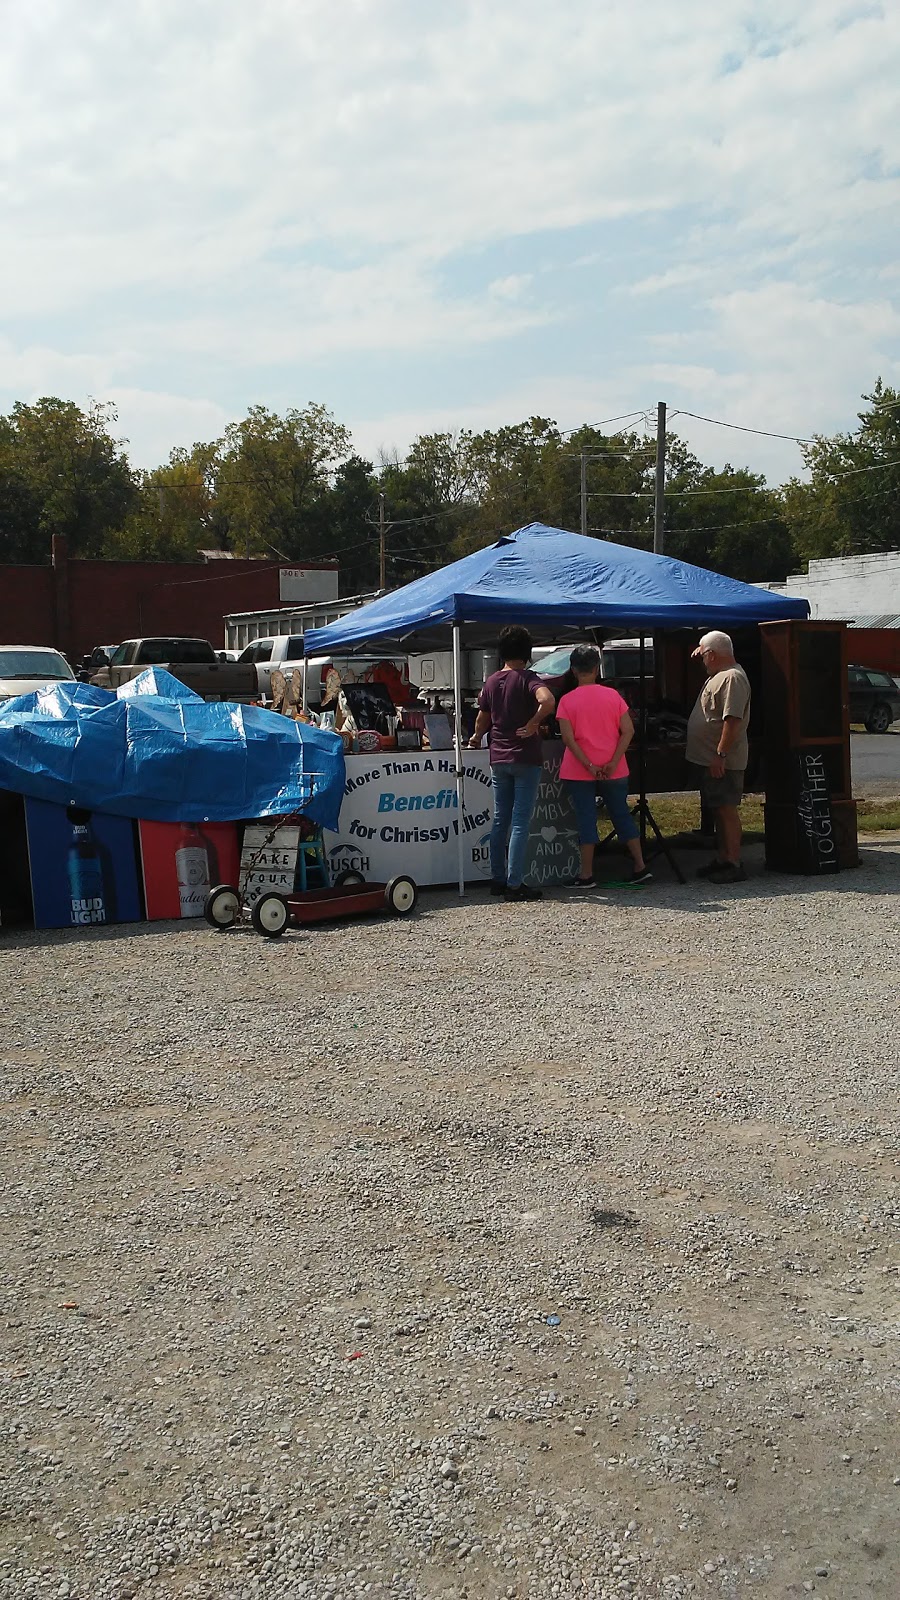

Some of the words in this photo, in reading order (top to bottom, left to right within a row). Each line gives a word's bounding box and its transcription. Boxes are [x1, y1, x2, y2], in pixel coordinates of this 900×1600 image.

[344, 769, 381, 796] More
[382, 761, 420, 776] Than
[423, 759, 434, 772] A
[378, 789, 458, 813] Benefit
[805, 753, 837, 867] TOGETHER
[349, 819, 377, 839] for
[379, 825, 450, 843] Chrissy
[535, 842, 563, 856] AND
[250, 853, 289, 865] TAKE
[249, 873, 288, 884] YOUR
[522, 855, 579, 885] kind
[72, 897, 103, 911] BUD
[71, 909, 106, 924] LIGHT
